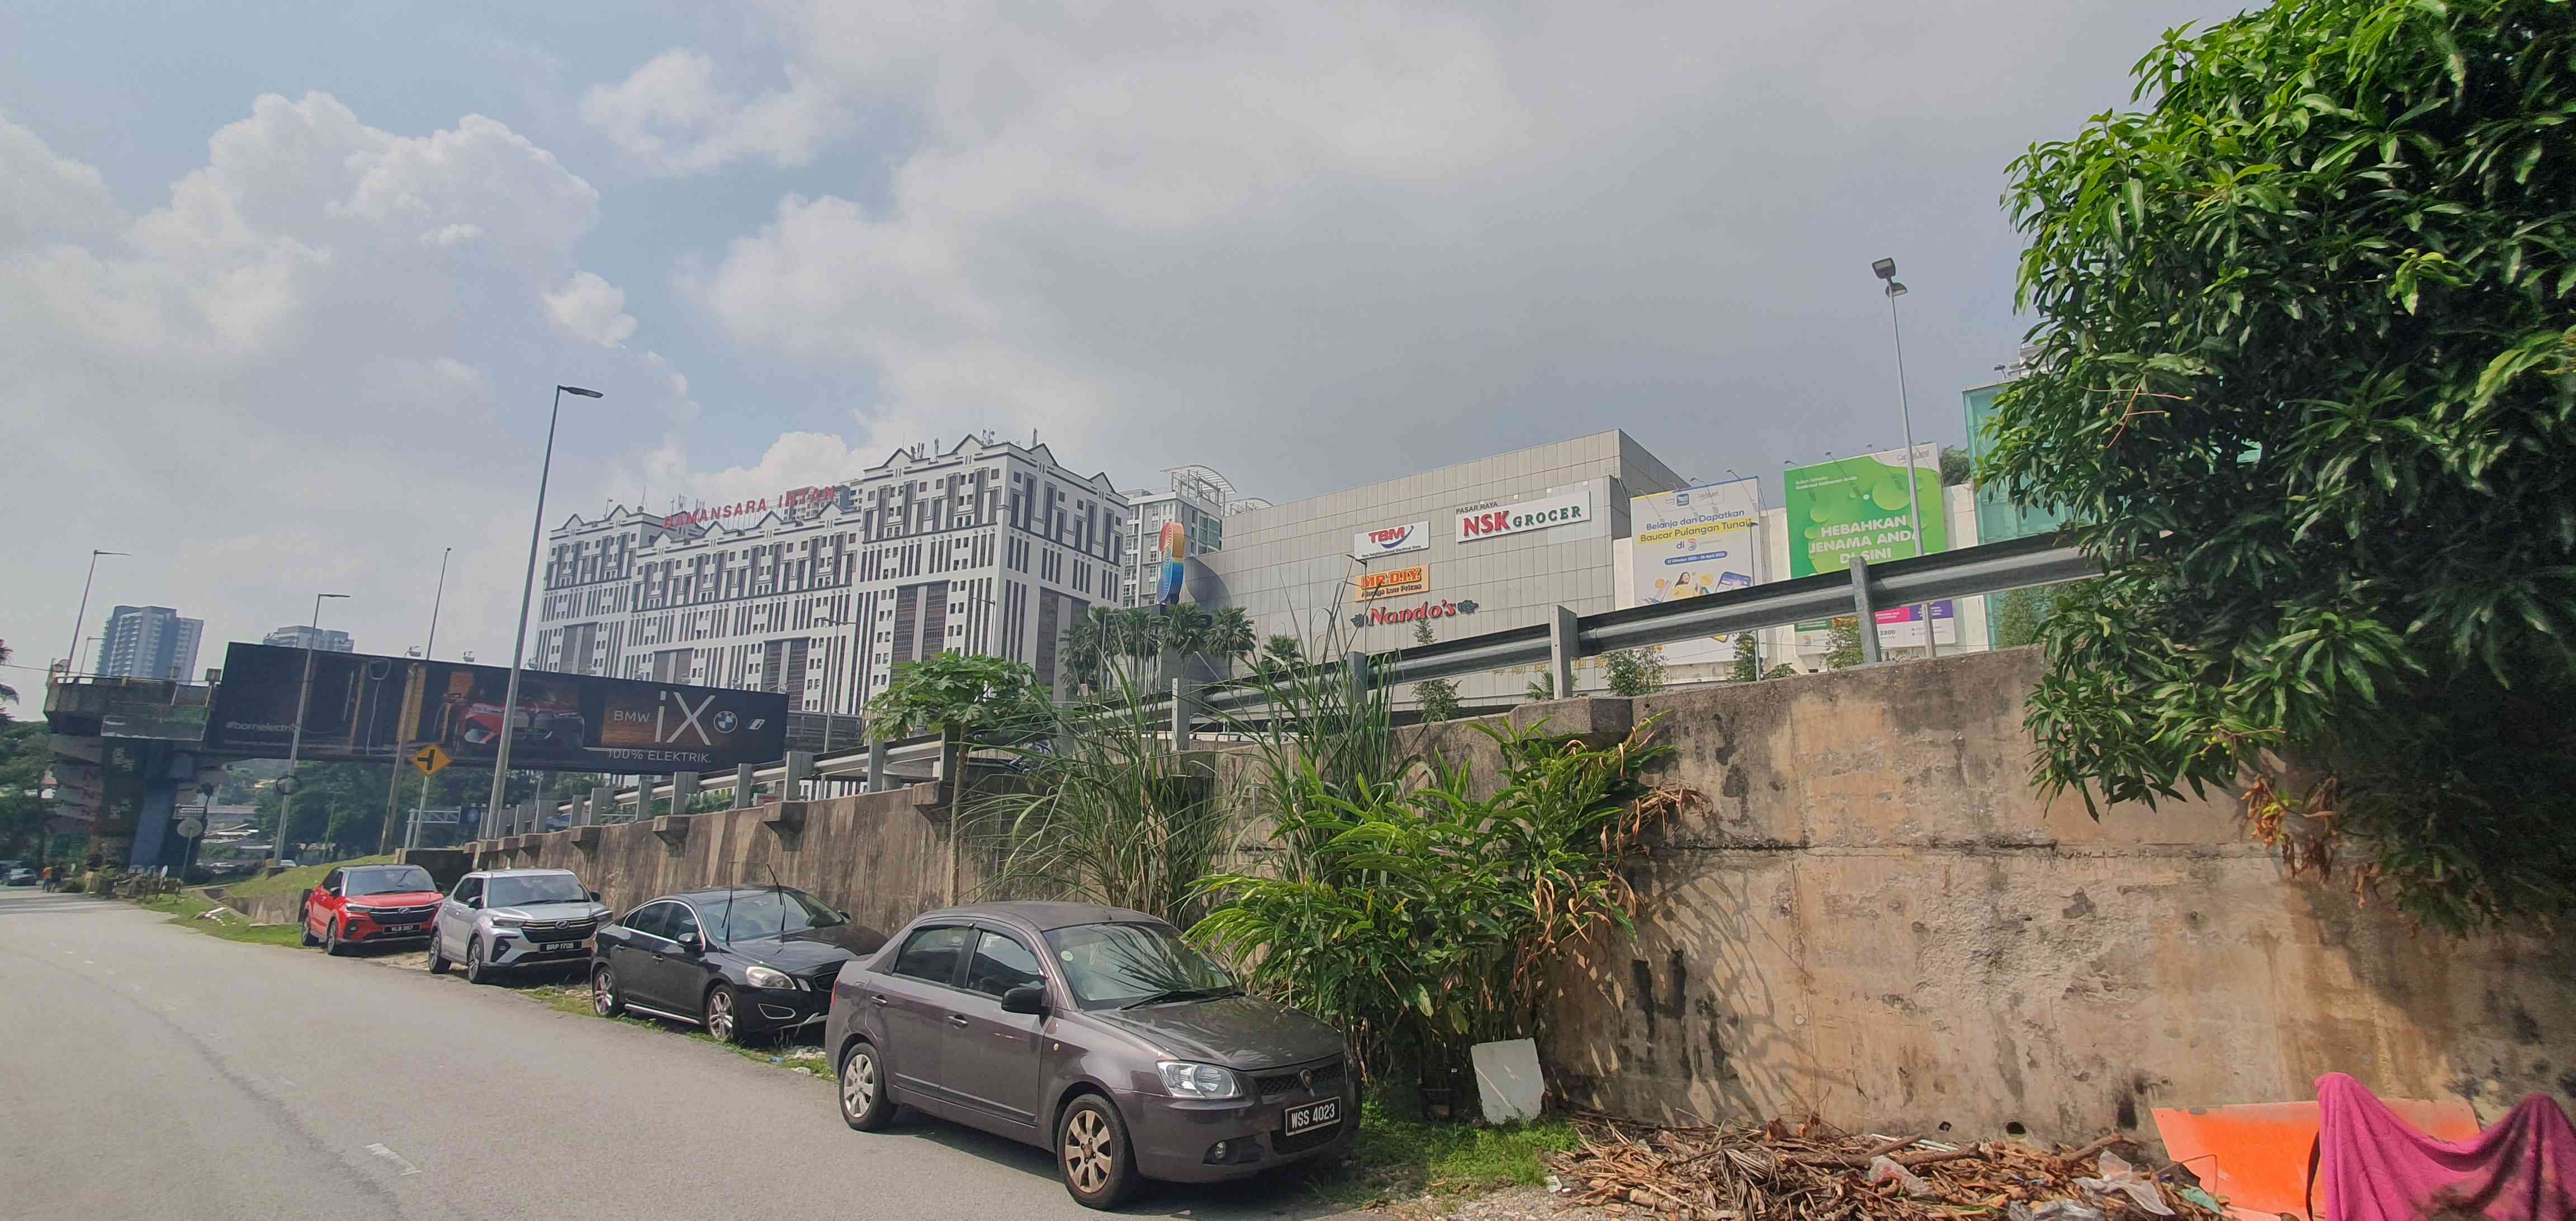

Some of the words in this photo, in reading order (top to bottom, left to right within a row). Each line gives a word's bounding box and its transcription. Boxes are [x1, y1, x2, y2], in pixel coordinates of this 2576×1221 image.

[662, 498, 767, 529] DAMANSARA
[778, 485, 835, 508] INTAN
[1456, 505, 1481, 514] PASAR
[1480, 501, 1498, 510] RAYA
[1463, 510, 1512, 537] NSK
[1513, 505, 1581, 527] GROCER
[1646, 522, 1678, 532] Belanja
[1699, 509, 1745, 523] Dapatkan
[1821, 515, 1907, 537] HEBAHKAN
[1368, 527, 1405, 543] TBM
[1640, 531, 1673, 542] Baucar
[1674, 524, 1720, 537] Pulangan
[1808, 536, 1872, 553] JENAMA
[1877, 531, 1917, 545] AND
[1862, 547, 1892, 561] SINI
[1369, 599, 1457, 626] Nando's
[226, 721, 296, 732] #bornelectri
[614, 711, 650, 723] BMW
[655, 690, 716, 745] iX
[608, 749, 643, 760] 100%
[647, 750, 711, 763] ELEKTRIK.
[1291, 1109, 1309, 1129] WSS
[1313, 1103, 1335, 1122] 4023
